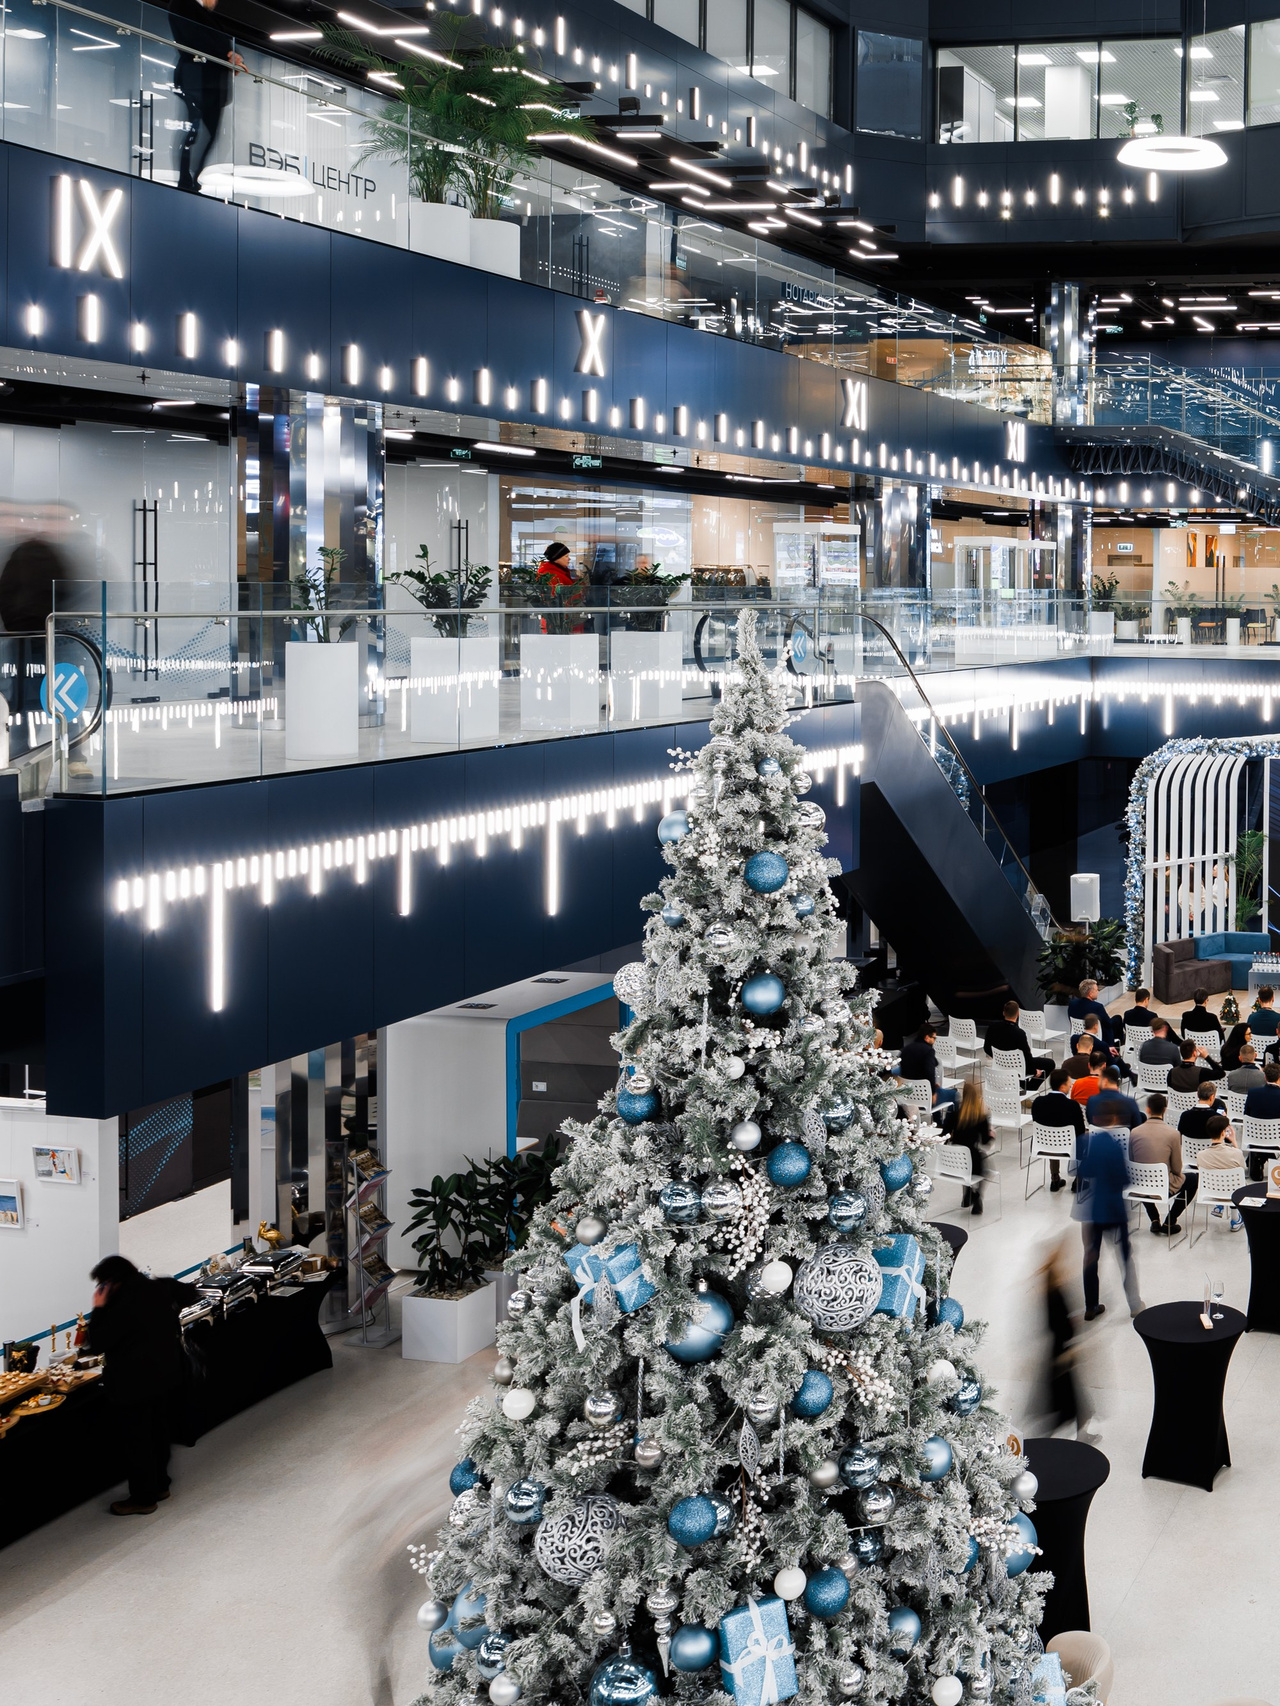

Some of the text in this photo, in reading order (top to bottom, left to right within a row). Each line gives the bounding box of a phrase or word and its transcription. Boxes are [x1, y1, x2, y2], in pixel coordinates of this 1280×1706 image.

[312, 162, 377, 200] ЦЕНТР
[59, 174, 124, 279] IX
[582, 309, 606, 378] X
[846, 378, 867, 431] XI
[1007, 420, 1026, 463] XII
